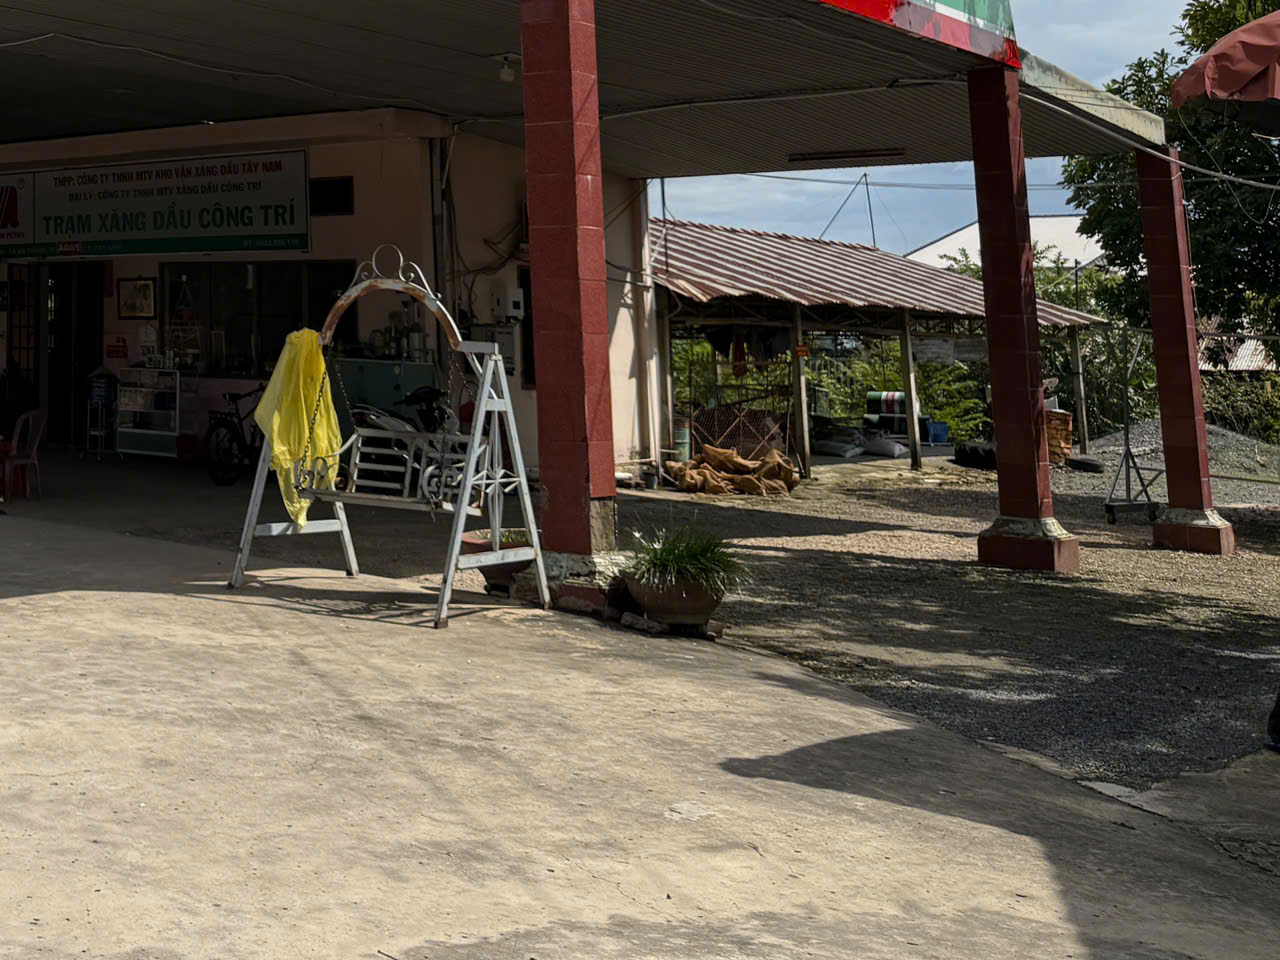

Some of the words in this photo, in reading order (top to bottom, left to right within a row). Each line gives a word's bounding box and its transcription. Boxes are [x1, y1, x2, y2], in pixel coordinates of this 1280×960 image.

[42, 213, 92, 238] TRẠM
[97, 208, 147, 233] XĂNG
[152, 201, 192, 231] DẦU
[198, 201, 254, 229] CÔNG
[260, 197, 296, 226] TRÍ
